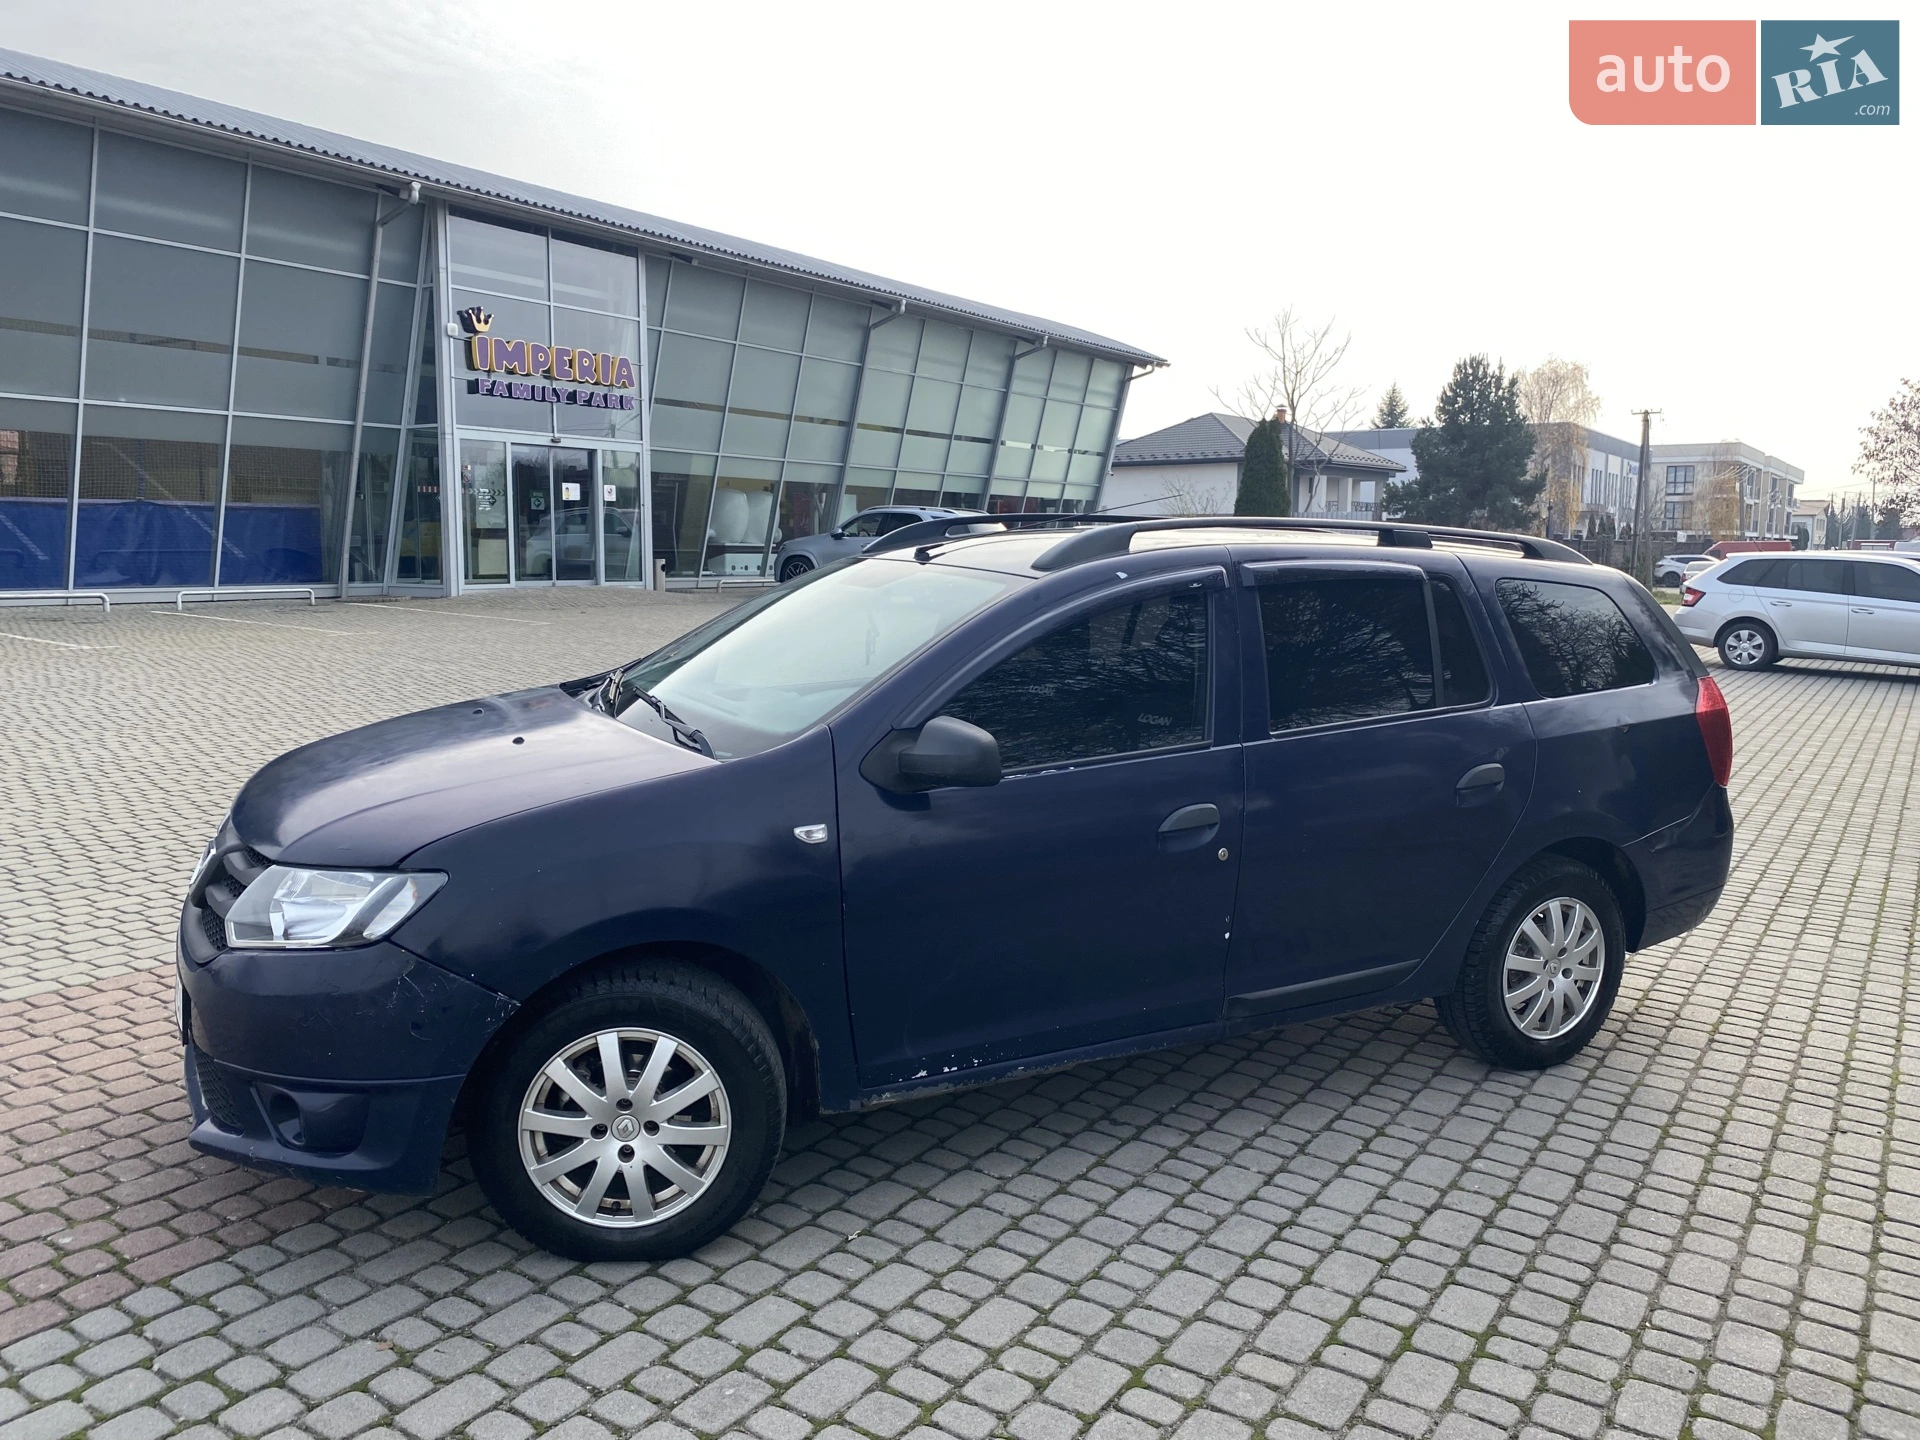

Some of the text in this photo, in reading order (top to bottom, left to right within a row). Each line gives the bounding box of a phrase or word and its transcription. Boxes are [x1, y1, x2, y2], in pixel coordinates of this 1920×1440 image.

[474, 335, 636, 389] IMPERIA
[477, 378, 636, 410] FAMILY PARK
[1137, 713, 1173, 726] LOGAN
